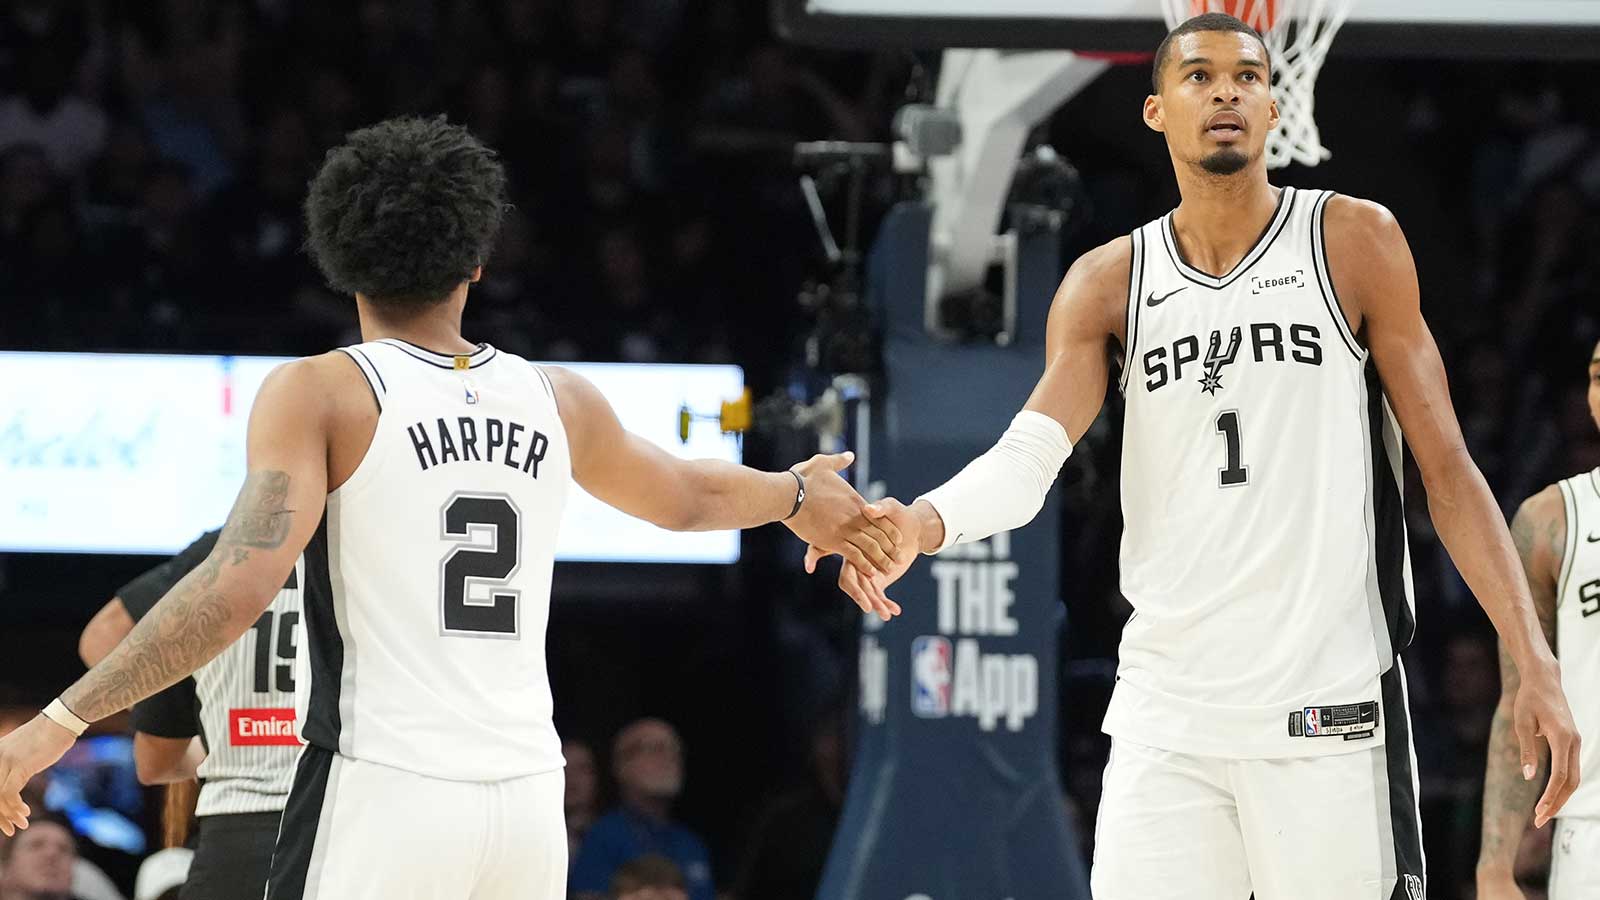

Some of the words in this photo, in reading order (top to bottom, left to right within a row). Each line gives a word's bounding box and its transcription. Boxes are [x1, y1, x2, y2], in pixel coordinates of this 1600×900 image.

[1258, 275, 1298, 289] LEDGER
[1143, 322, 1323, 396] SPURS
[407, 416, 549, 480] HARPER
[1214, 409, 1249, 488] 1
[439, 490, 522, 640] 2
[931, 560, 1019, 636] THE
[952, 637, 1039, 732] App
